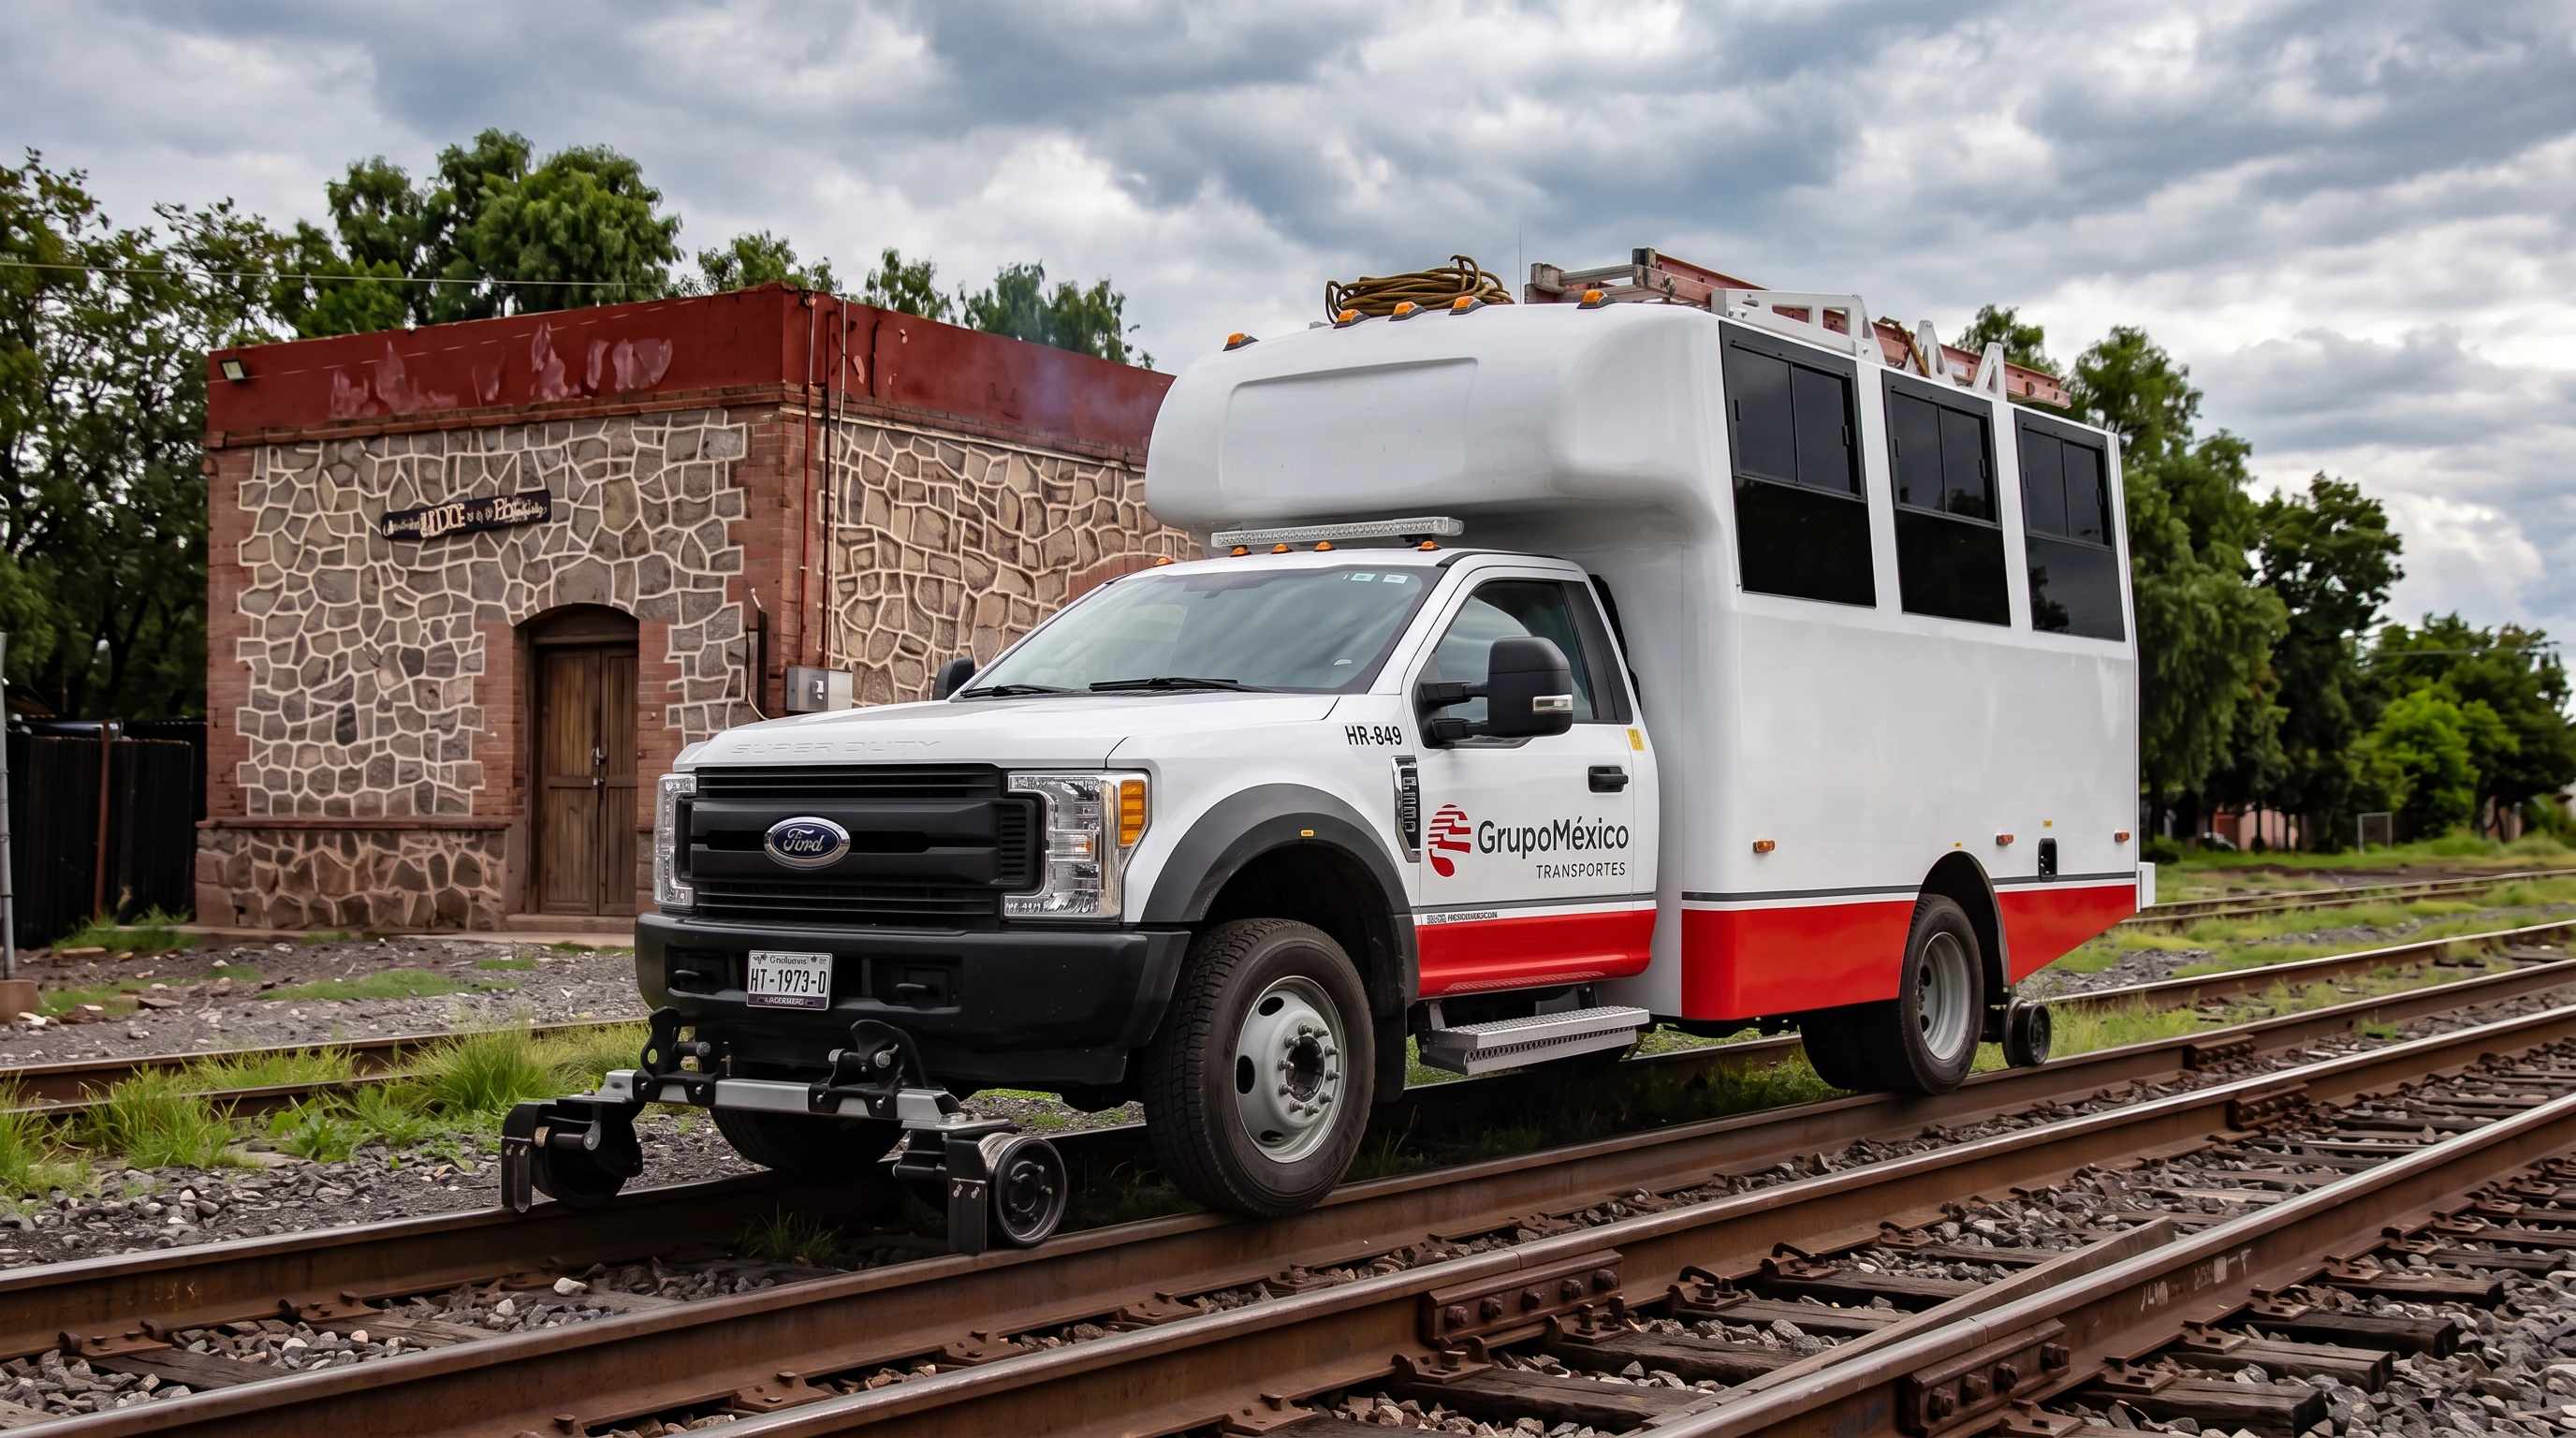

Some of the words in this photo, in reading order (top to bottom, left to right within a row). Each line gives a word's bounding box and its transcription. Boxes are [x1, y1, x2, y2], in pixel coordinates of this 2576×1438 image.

[1345, 726, 1402, 746] HR-849
[731, 741, 834, 756] SUPER
[844, 741, 942, 754] DUTY
[783, 828, 826, 852] Ford
[1478, 816, 1629, 859] GrupoMéxico
[1536, 862, 1626, 879] TRANSPORTES
